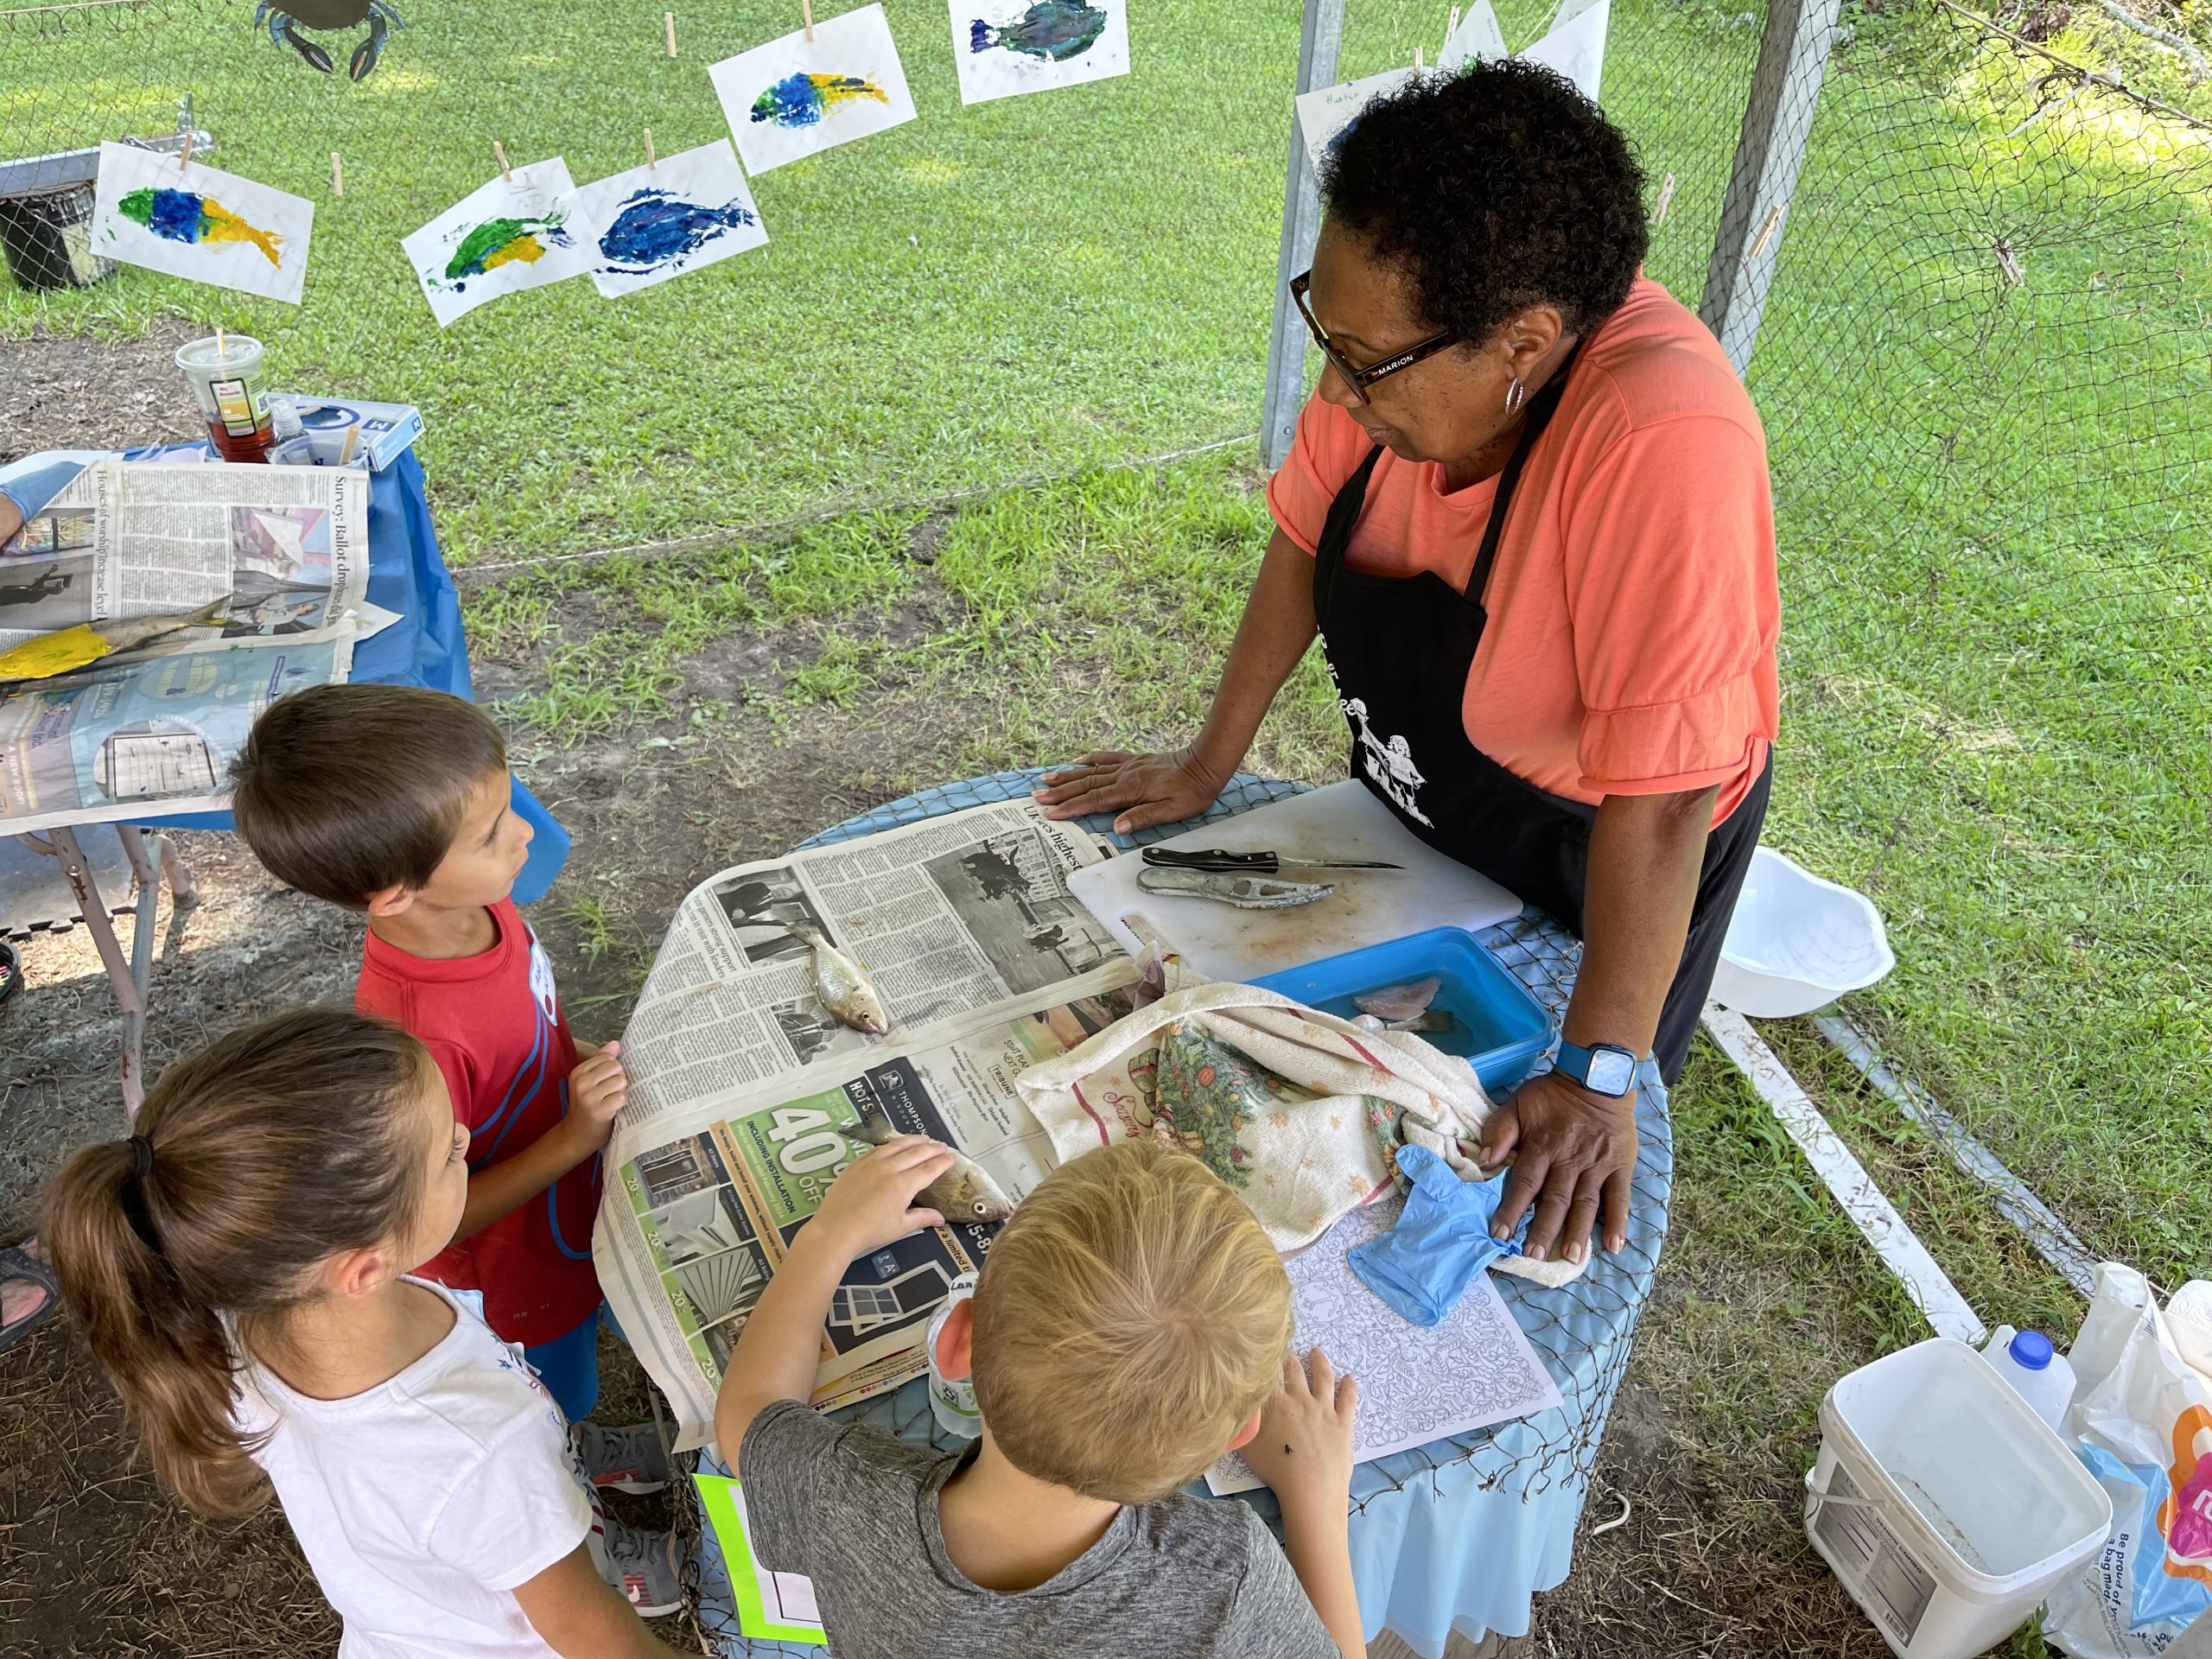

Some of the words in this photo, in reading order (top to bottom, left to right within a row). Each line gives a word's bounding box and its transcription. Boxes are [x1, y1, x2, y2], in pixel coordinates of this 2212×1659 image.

[1378, 354, 1414, 375] MARION
[335, 476, 347, 522] Survey:
[335, 524, 350, 561] Ballot
[1001, 1052, 1015, 1068] NEXT
[849, 1080, 869, 1104] HOT
[993, 1067, 1013, 1095] TRIBUNE
[899, 1090, 927, 1135] THOMPSON
[1103, 1090, 1147, 1141] Seasons
[747, 1121, 770, 1159] INCLUDING
[766, 1156, 797, 1213] INSTALLATION
[945, 1238, 967, 1263] limited
[2119, 1533, 2129, 1548] Be
[2101, 1548, 2116, 1571] bag
[2115, 1551, 2125, 1589] proud
[2113, 1591, 2121, 1605] of
